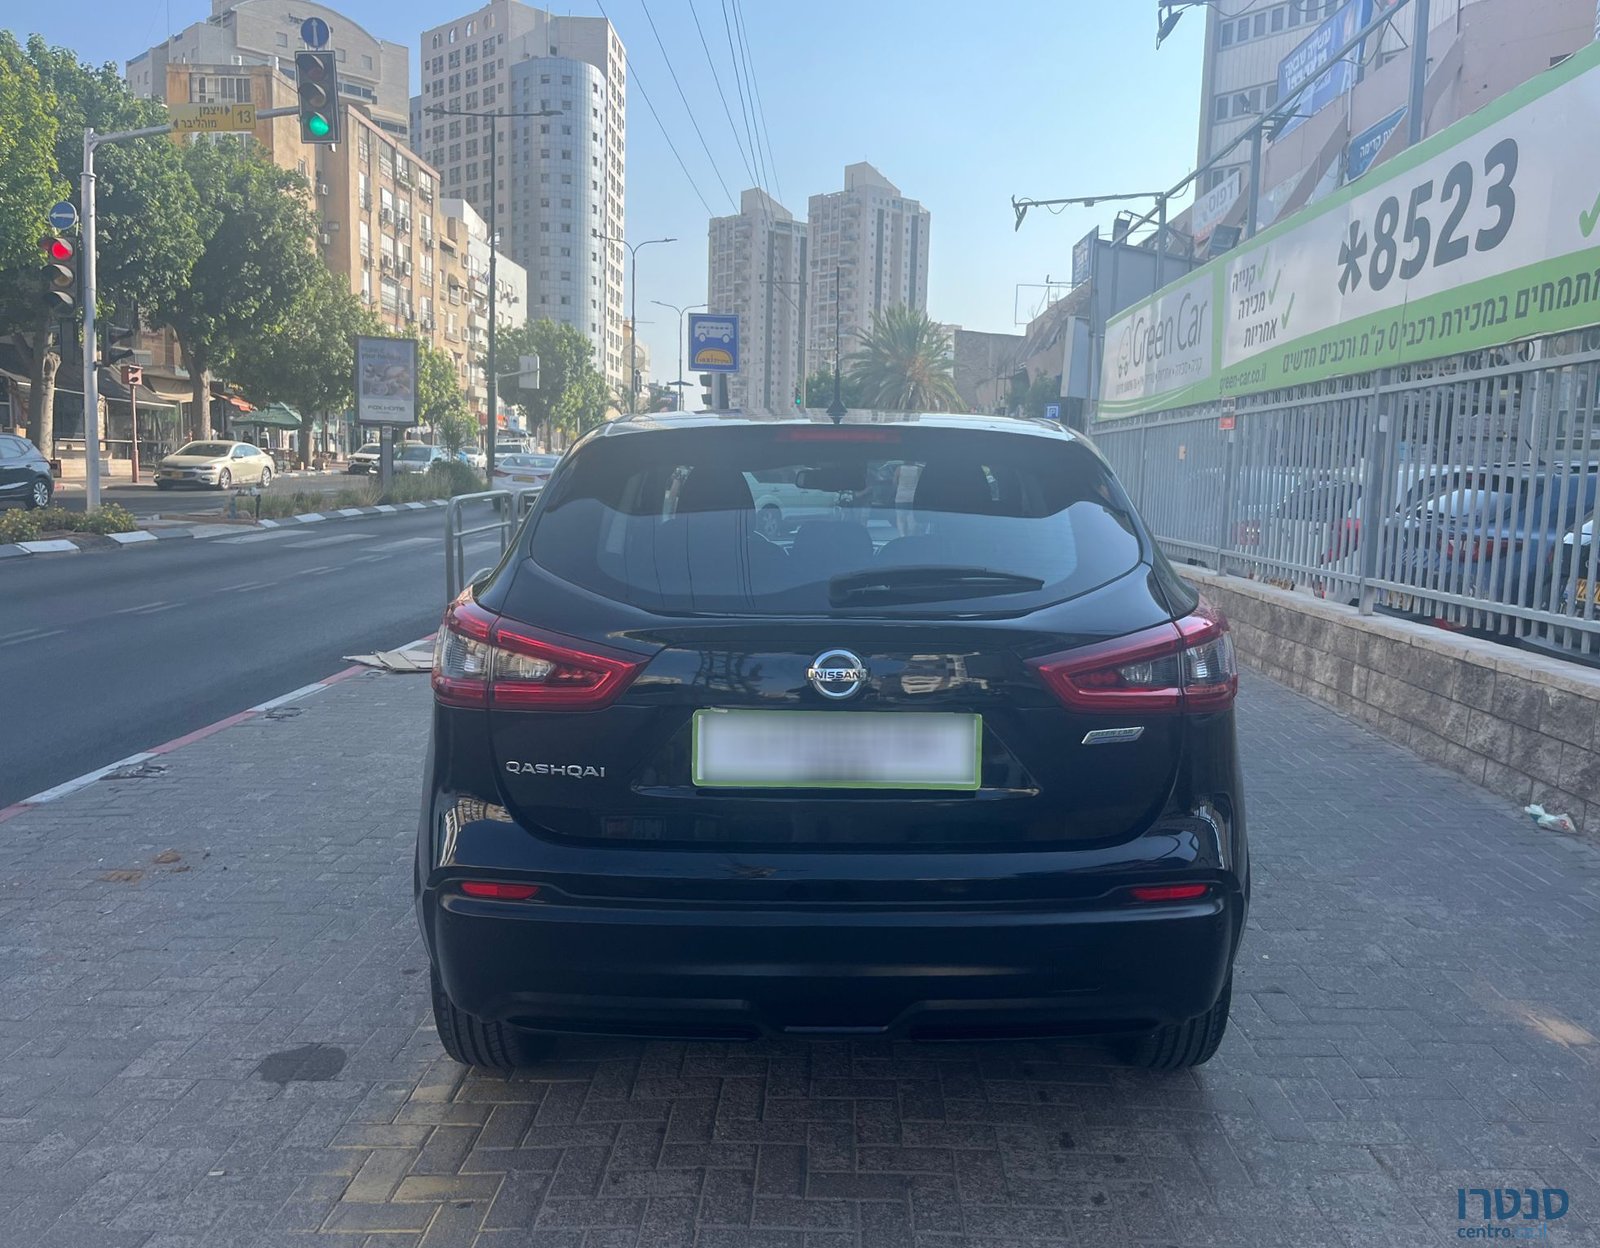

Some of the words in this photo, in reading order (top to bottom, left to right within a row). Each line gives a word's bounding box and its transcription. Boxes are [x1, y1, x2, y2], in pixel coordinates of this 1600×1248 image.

[181, 116, 217, 128] מוהליבר
[200, 106, 223, 117] ויצמן
[237, 110, 252, 124] 13
[1209, 182, 1234, 213] דפוס
[1232, 264, 1256, 293] קנייה
[1238, 291, 1266, 320] מכירה
[1438, 295, 1508, 339] במכירת
[1133, 316, 1173, 368] Green
[1177, 292, 1208, 351] Car
[1244, 318, 1277, 348] אחריות
[1283, 347, 1317, 374] חדשים
[1319, 336, 1356, 365] ורכבים
[815, 671, 861, 679] NISSAN
[505, 761, 605, 779] QASHQAI
